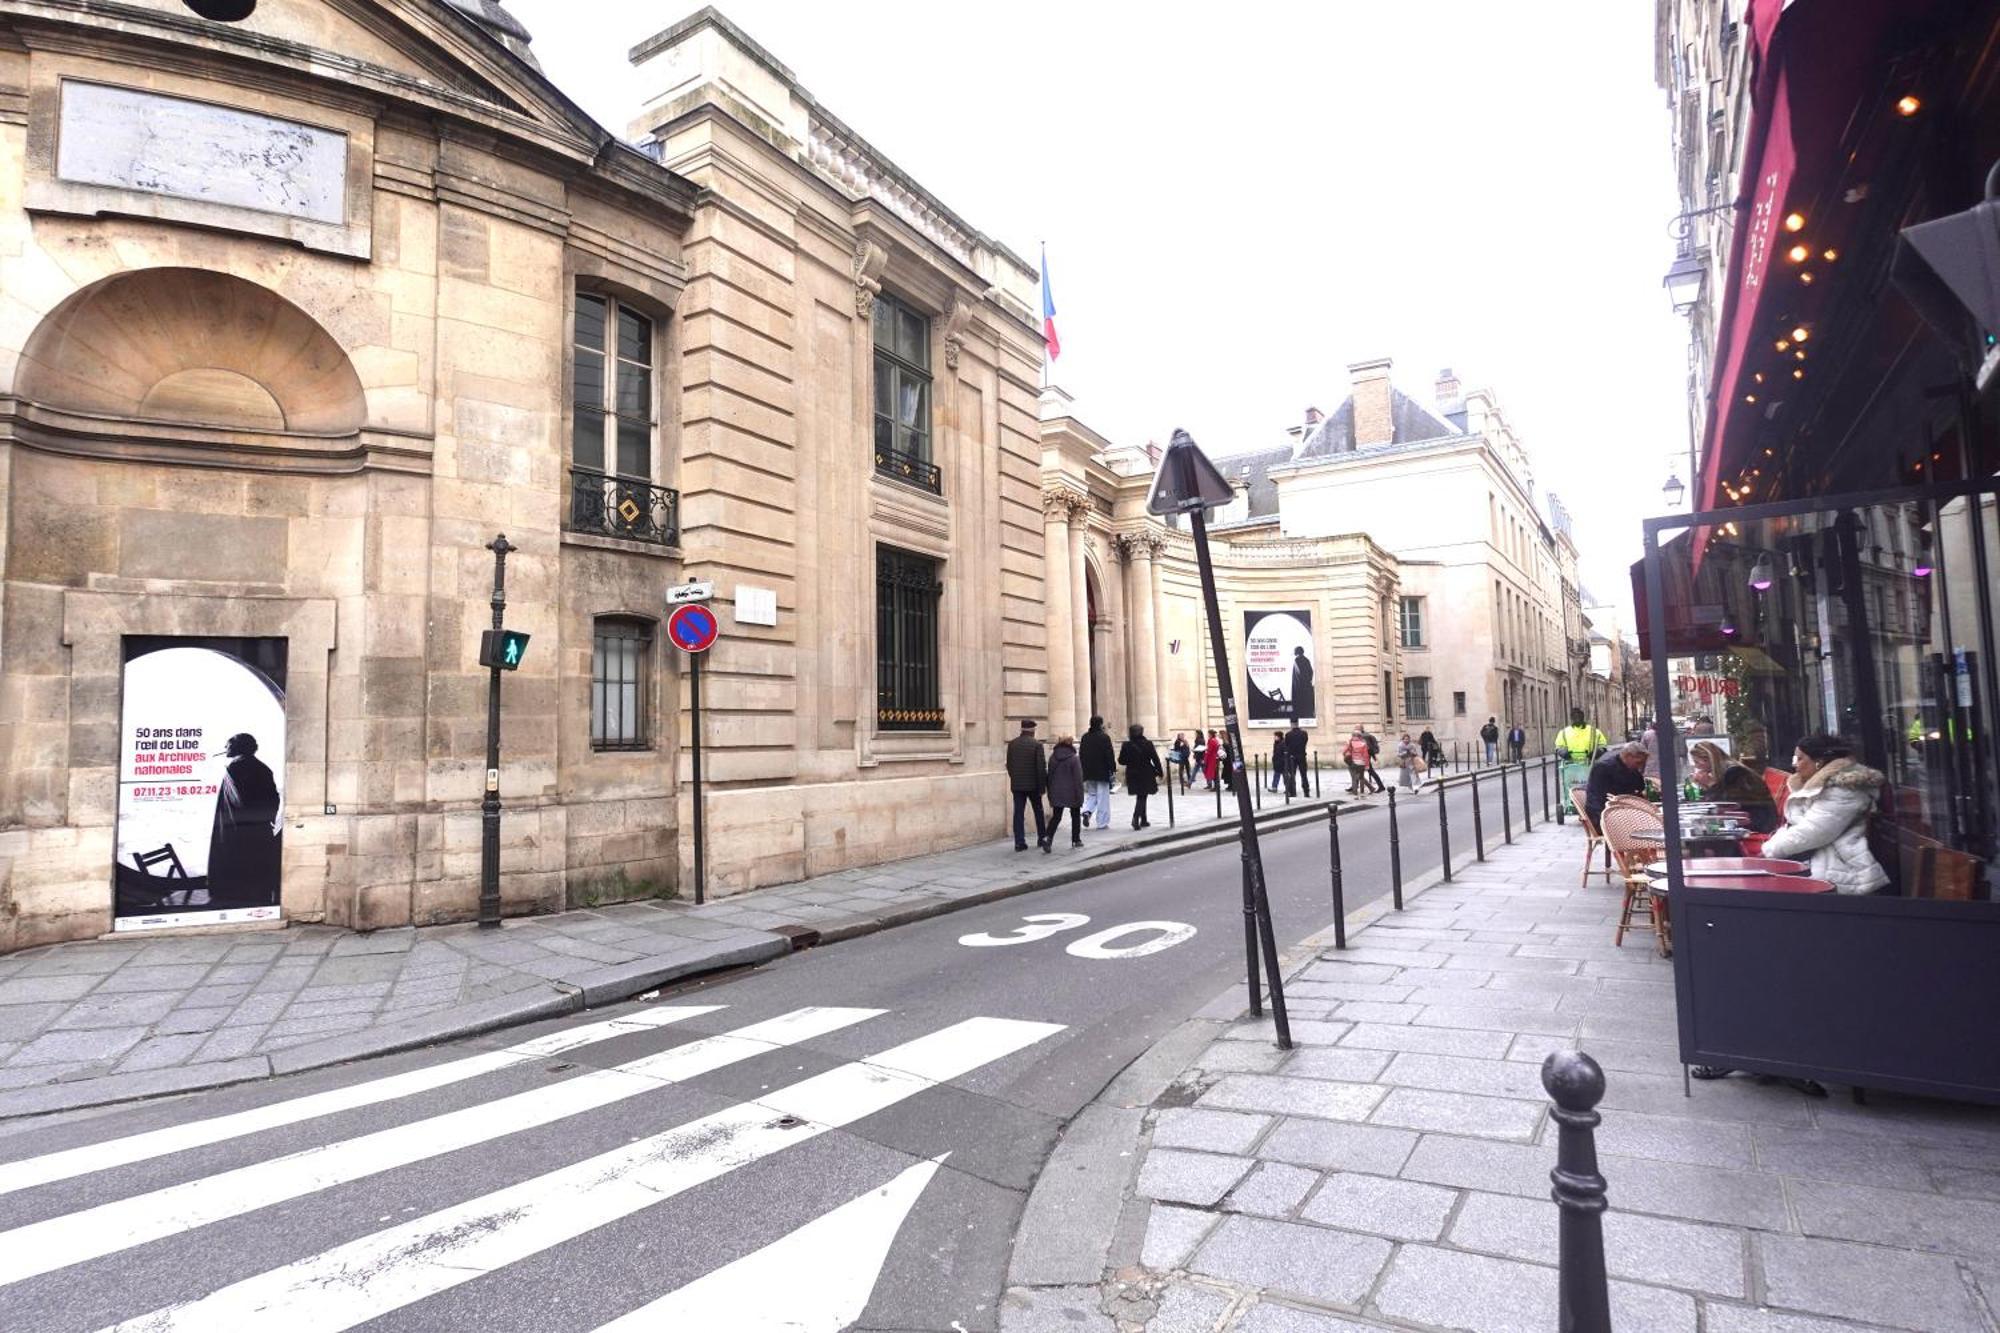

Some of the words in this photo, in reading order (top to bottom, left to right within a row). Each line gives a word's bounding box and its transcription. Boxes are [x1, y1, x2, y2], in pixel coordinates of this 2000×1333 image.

[136, 728, 150, 738] 50
[153, 728, 173, 737] ans
[176, 727, 202, 737] dans
[160, 740, 174, 749] de
[135, 754, 155, 763] aux
[158, 752, 206, 762] Archives
[135, 765, 193, 775] nationales
[958, 913, 1197, 959] 30
